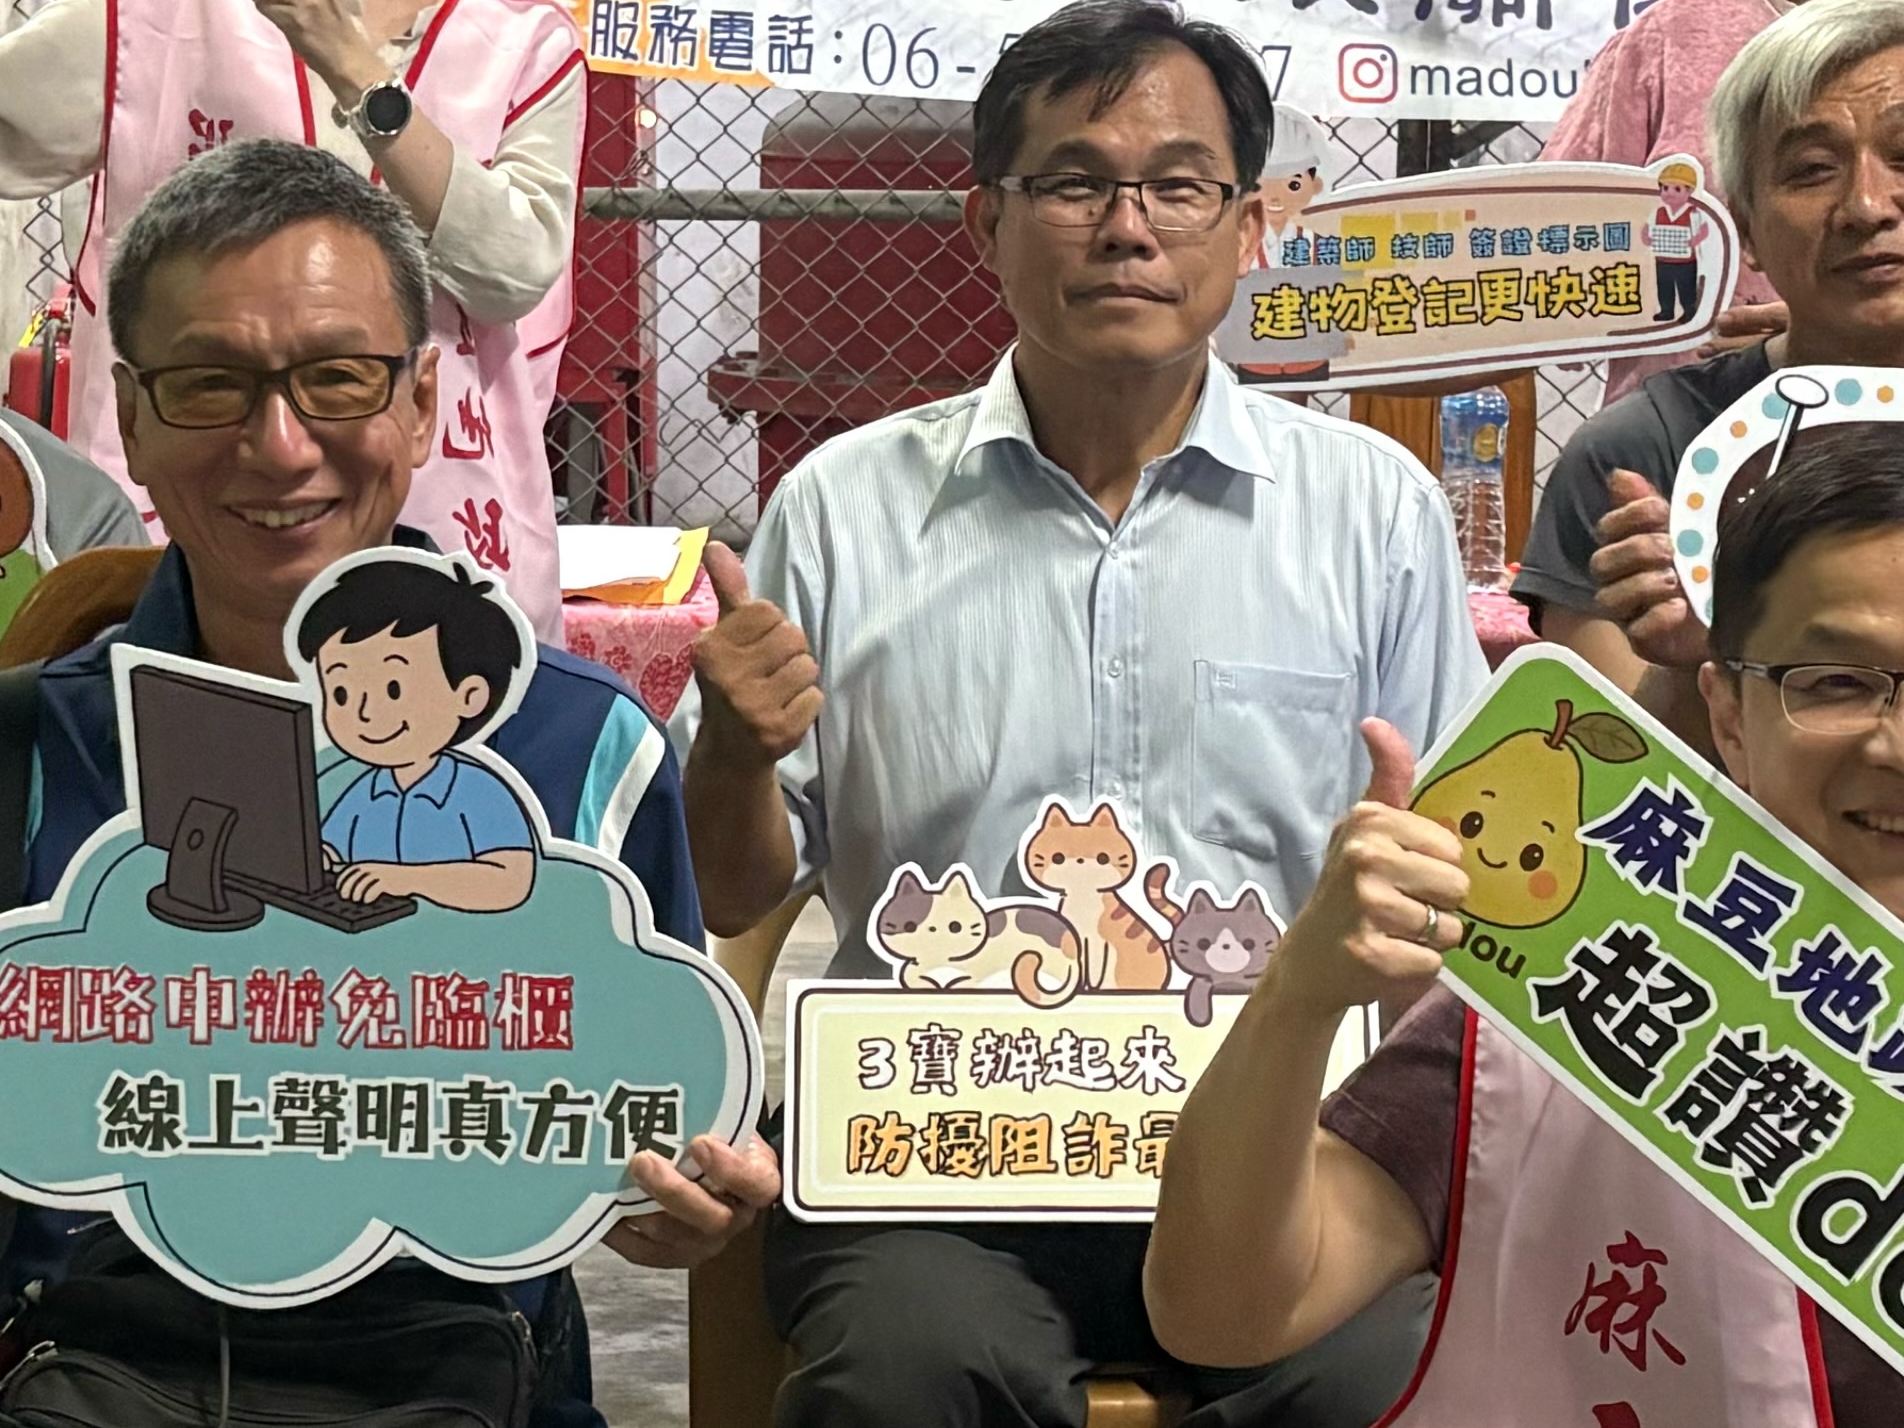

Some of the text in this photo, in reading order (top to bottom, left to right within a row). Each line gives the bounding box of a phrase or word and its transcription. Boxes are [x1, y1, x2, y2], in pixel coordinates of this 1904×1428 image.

[1410, 58, 1592, 98] madou
[1251, 262, 1643, 341] 建物登記更快速
[101, 1073, 685, 1165] 線上聲明真方便
